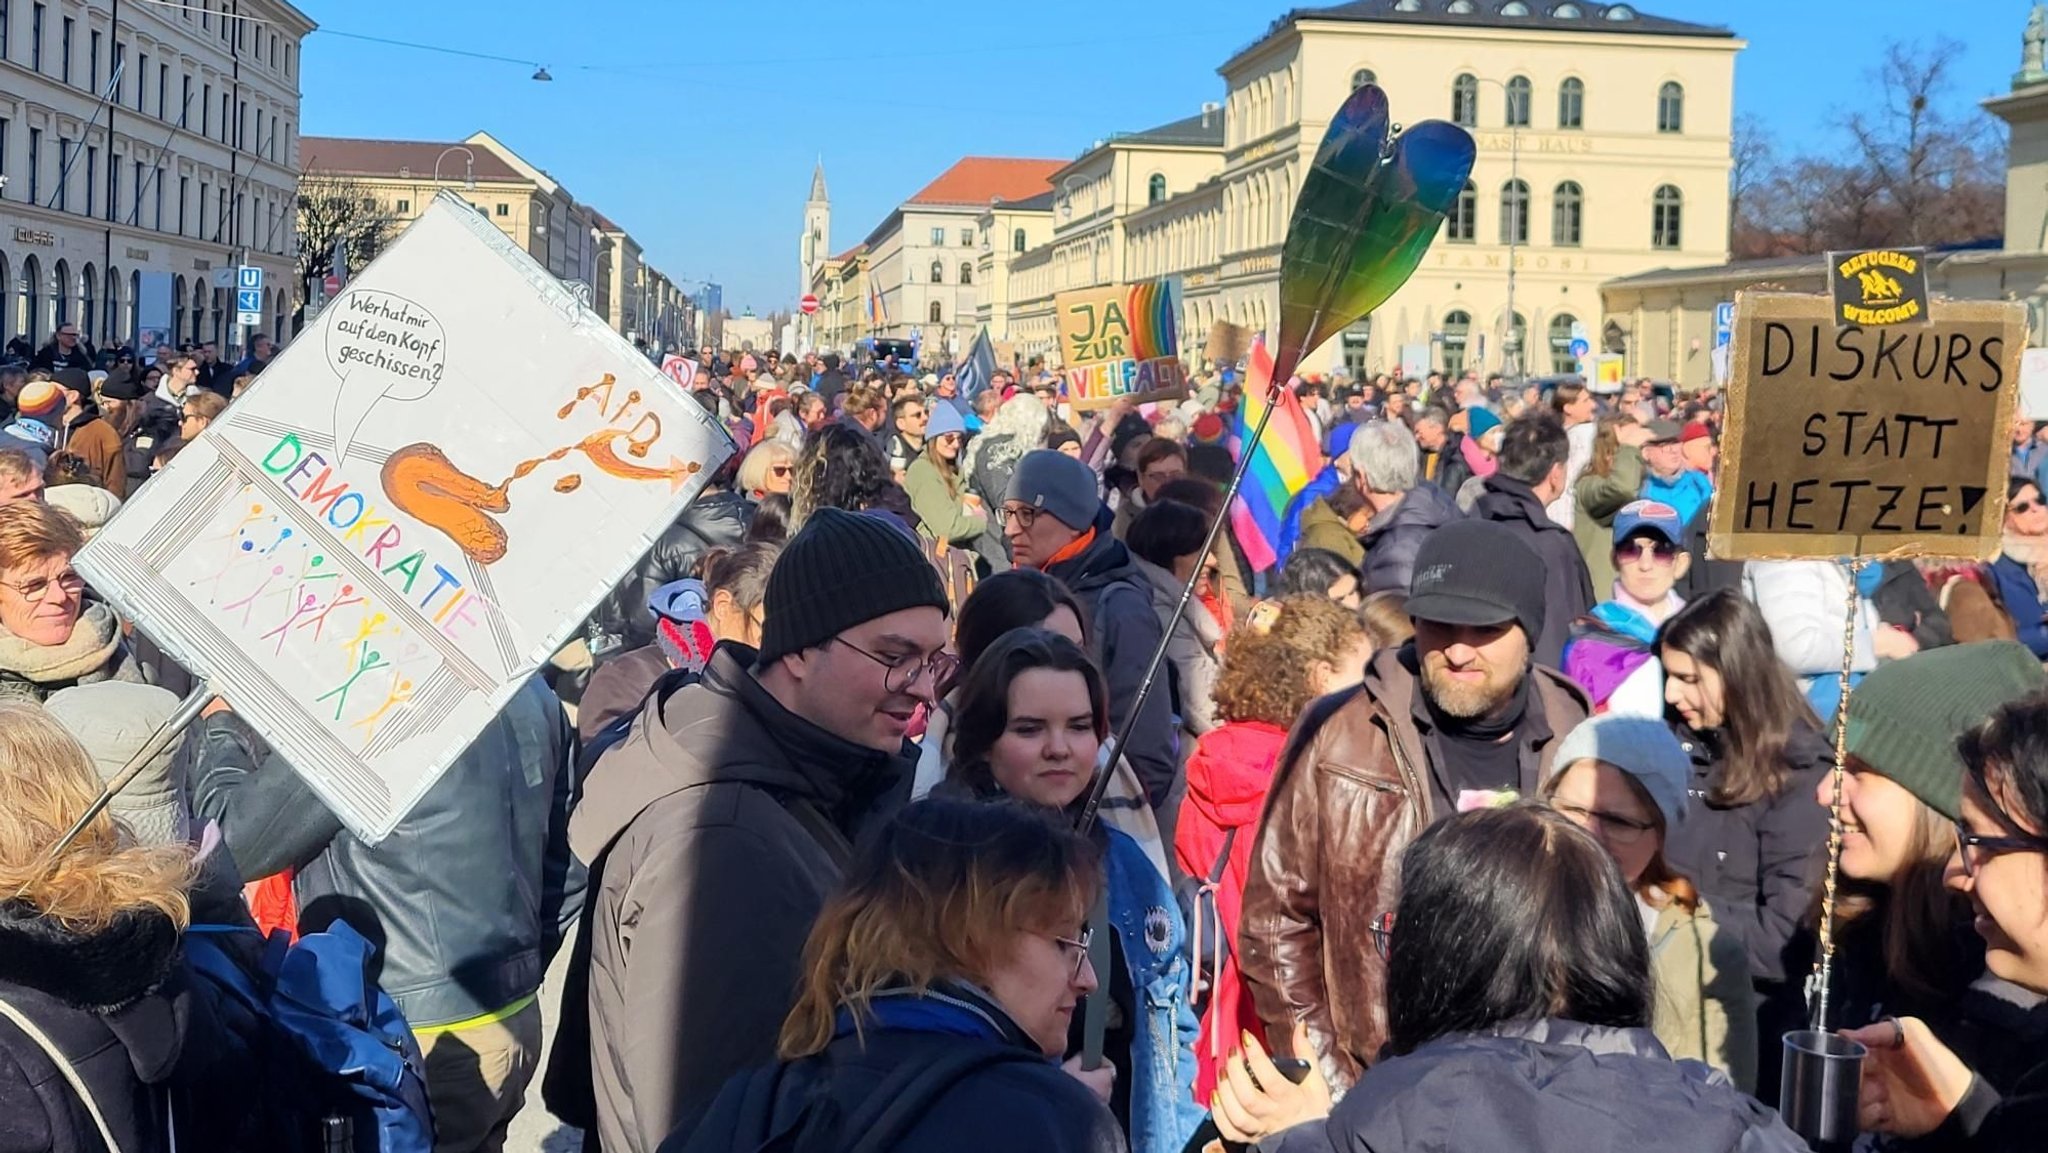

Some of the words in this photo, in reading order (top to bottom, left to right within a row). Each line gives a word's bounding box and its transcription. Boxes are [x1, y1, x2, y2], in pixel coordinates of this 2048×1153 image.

[244, 271, 257, 286] U
[1436, 253, 1590, 270] TAMBOSI
[1839, 250, 1917, 279] REFUGEES
[350, 293, 380, 315] Wer
[380, 300, 409, 322] hat
[406, 314, 430, 328] mir
[1069, 299, 1130, 343] JA
[1843, 299, 1919, 325] WELCOME
[337, 319, 369, 340] auf
[365, 323, 398, 345] den
[398, 331, 441, 362] Kopf
[1072, 335, 1126, 362] ZUR
[1761, 322, 2004, 393] DISKURS
[338, 345, 443, 385] geschissen?
[1069, 358, 1179, 400] VIELFALT
[557, 372, 662, 458] AfD
[1802, 411, 1958, 459] STATT
[1744, 480, 1988, 535] HETZE!
[261, 432, 488, 640] DEMOKRATIE
